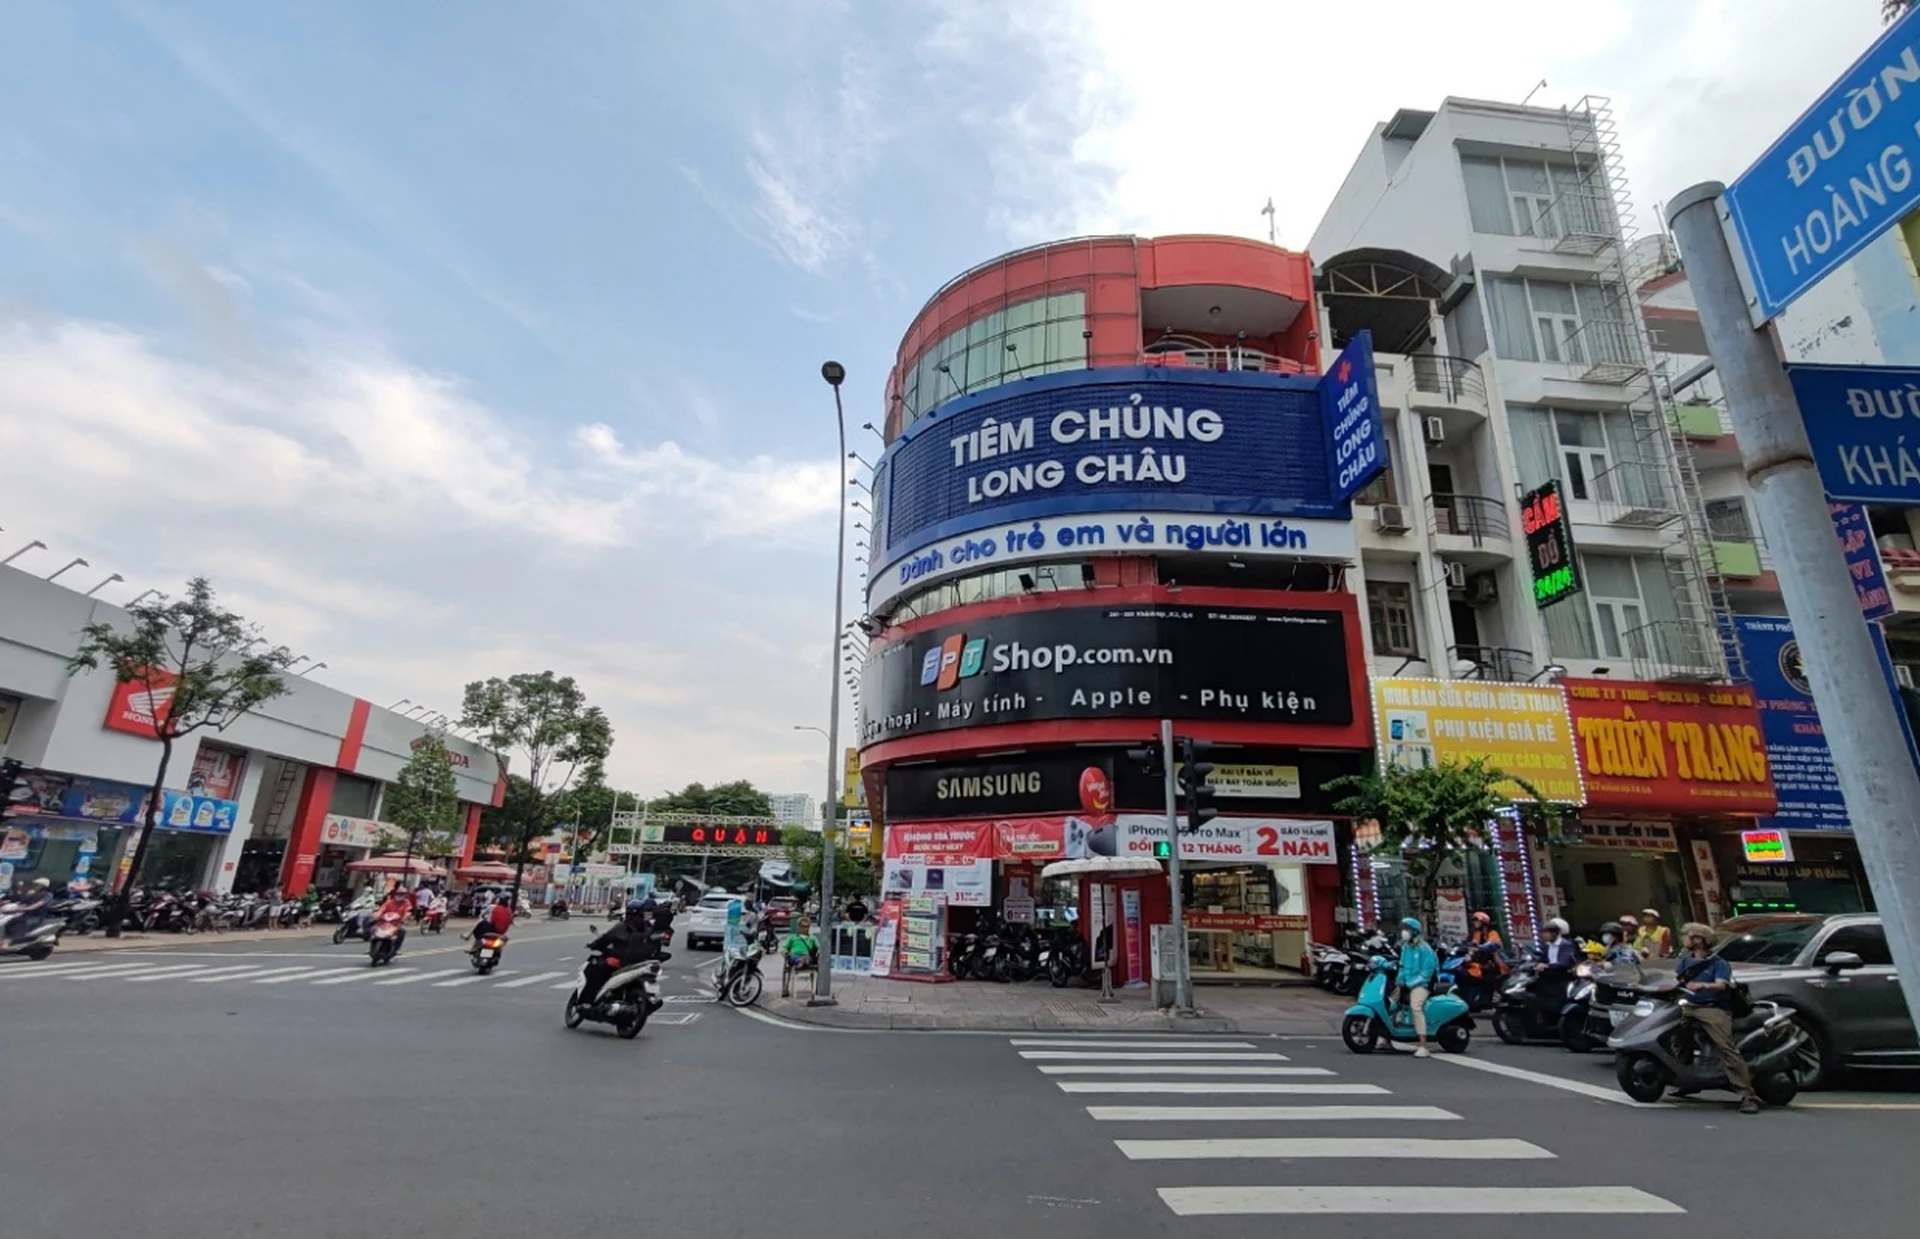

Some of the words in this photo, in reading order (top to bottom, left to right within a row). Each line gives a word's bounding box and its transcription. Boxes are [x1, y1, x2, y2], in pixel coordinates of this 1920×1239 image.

[1787, 46, 1920, 187] ĐƯỜN
[1781, 144, 1911, 276] HOÀNG
[1333, 396, 1368, 440] CHỦNG
[1337, 381, 1359, 413] TIÊM
[951, 417, 1034, 466] TIÊM
[1050, 392, 1224, 443] CHỦNG
[1336, 419, 1371, 466] LONG
[968, 459, 1065, 503] LONG
[1075, 446, 1186, 483] CHÂU
[1339, 441, 1376, 489] CHÂU
[1838, 436, 1920, 487] KHÁ
[900, 549, 943, 586] Dành
[950, 538, 997, 565] cho
[1006, 521, 1045, 553] trẻ
[1057, 524, 1104, 547] em
[1116, 515, 1154, 544] và
[1166, 518, 1251, 551] người
[1260, 520, 1307, 549] lớn
[992, 641, 1173, 674] Shop.com.vn
[883, 707, 919, 731] thoại
[938, 699, 974, 720] Máy
[983, 693, 1027, 713] tính
[1071, 687, 1151, 709] Apple
[1201, 690, 1249, 712] Phụ
[1262, 691, 1316, 714] kiện
[1383, 687, 1411, 707] MUA
[1412, 685, 1437, 706] BÁN
[1439, 688, 1465, 708] SỬA
[1434, 719, 1466, 742] PHỤ
[1468, 717, 1505, 743] KIỆN
[1508, 719, 1534, 740] GIÁ
[1536, 718, 1558, 741] RẺ
[1577, 704, 1668, 779] THIÊN
[1667, 721, 1766, 783] TRANG
[937, 771, 1041, 799] SAMSUNG
[692, 829, 768, 845] QUẬN
[1182, 842, 1195, 852] 12
[1199, 840, 1243, 855] THÁNG
[1215, 828, 1241, 838] Max
[1256, 826, 1281, 856] 2
[1283, 837, 1330, 857] NĂM
